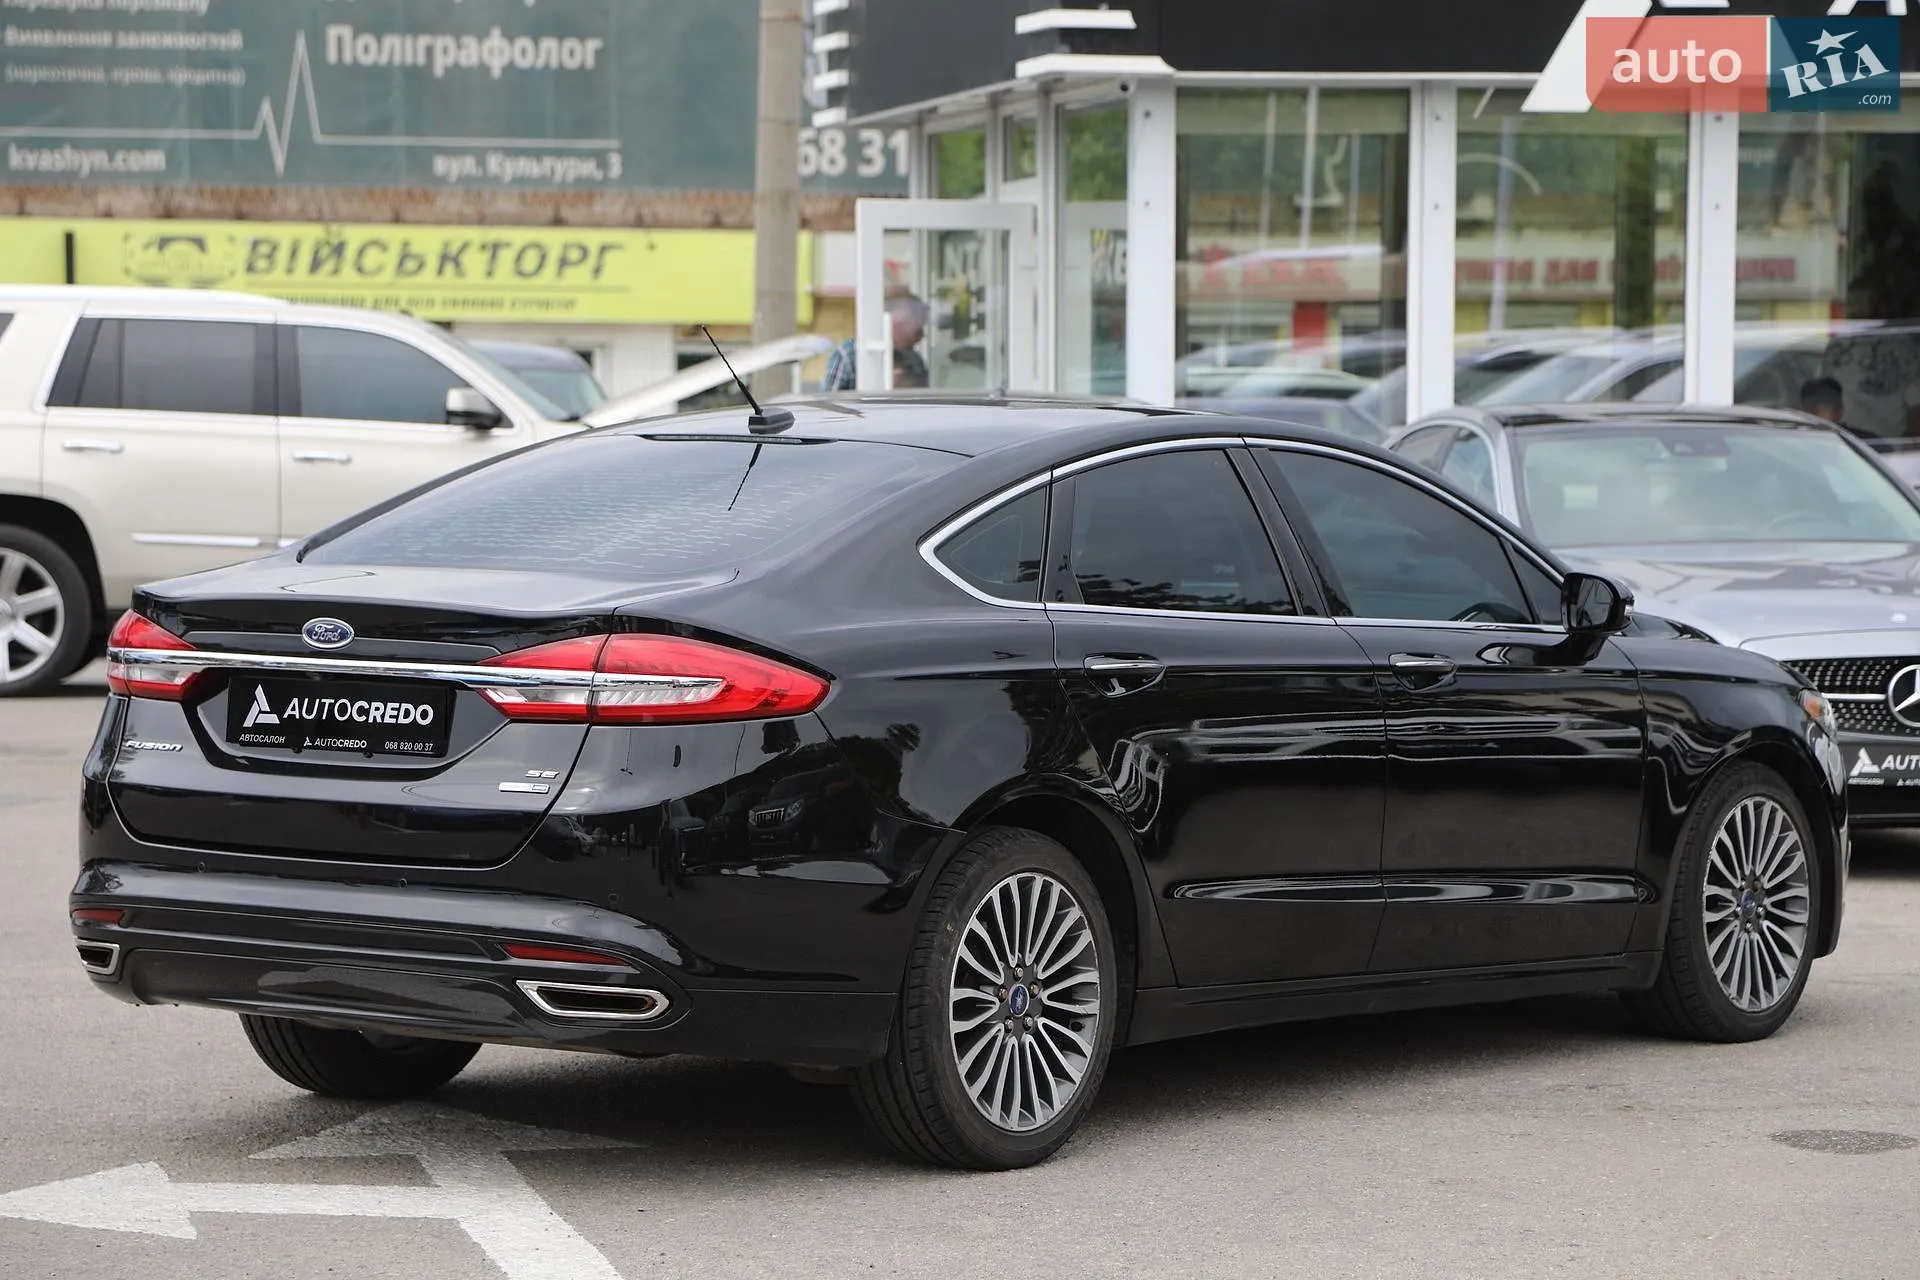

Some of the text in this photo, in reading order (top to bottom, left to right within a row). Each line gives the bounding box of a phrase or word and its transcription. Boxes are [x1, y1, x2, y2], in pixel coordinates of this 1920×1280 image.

[325, 23, 604, 80] Поліграфолог
[856, 128, 909, 177] 31
[246, 234, 624, 281] ВІЙСЬКТОРГ
[312, 624, 341, 641] Ford
[283, 697, 434, 726] AUTOCREDO
[239, 733, 286, 744] АВТОСАЛОН
[314, 737, 367, 749] AUTOCREDO
[384, 741, 397, 750] 068
[414, 743, 424, 751] 00
[1881, 754, 1920, 770] AUT
